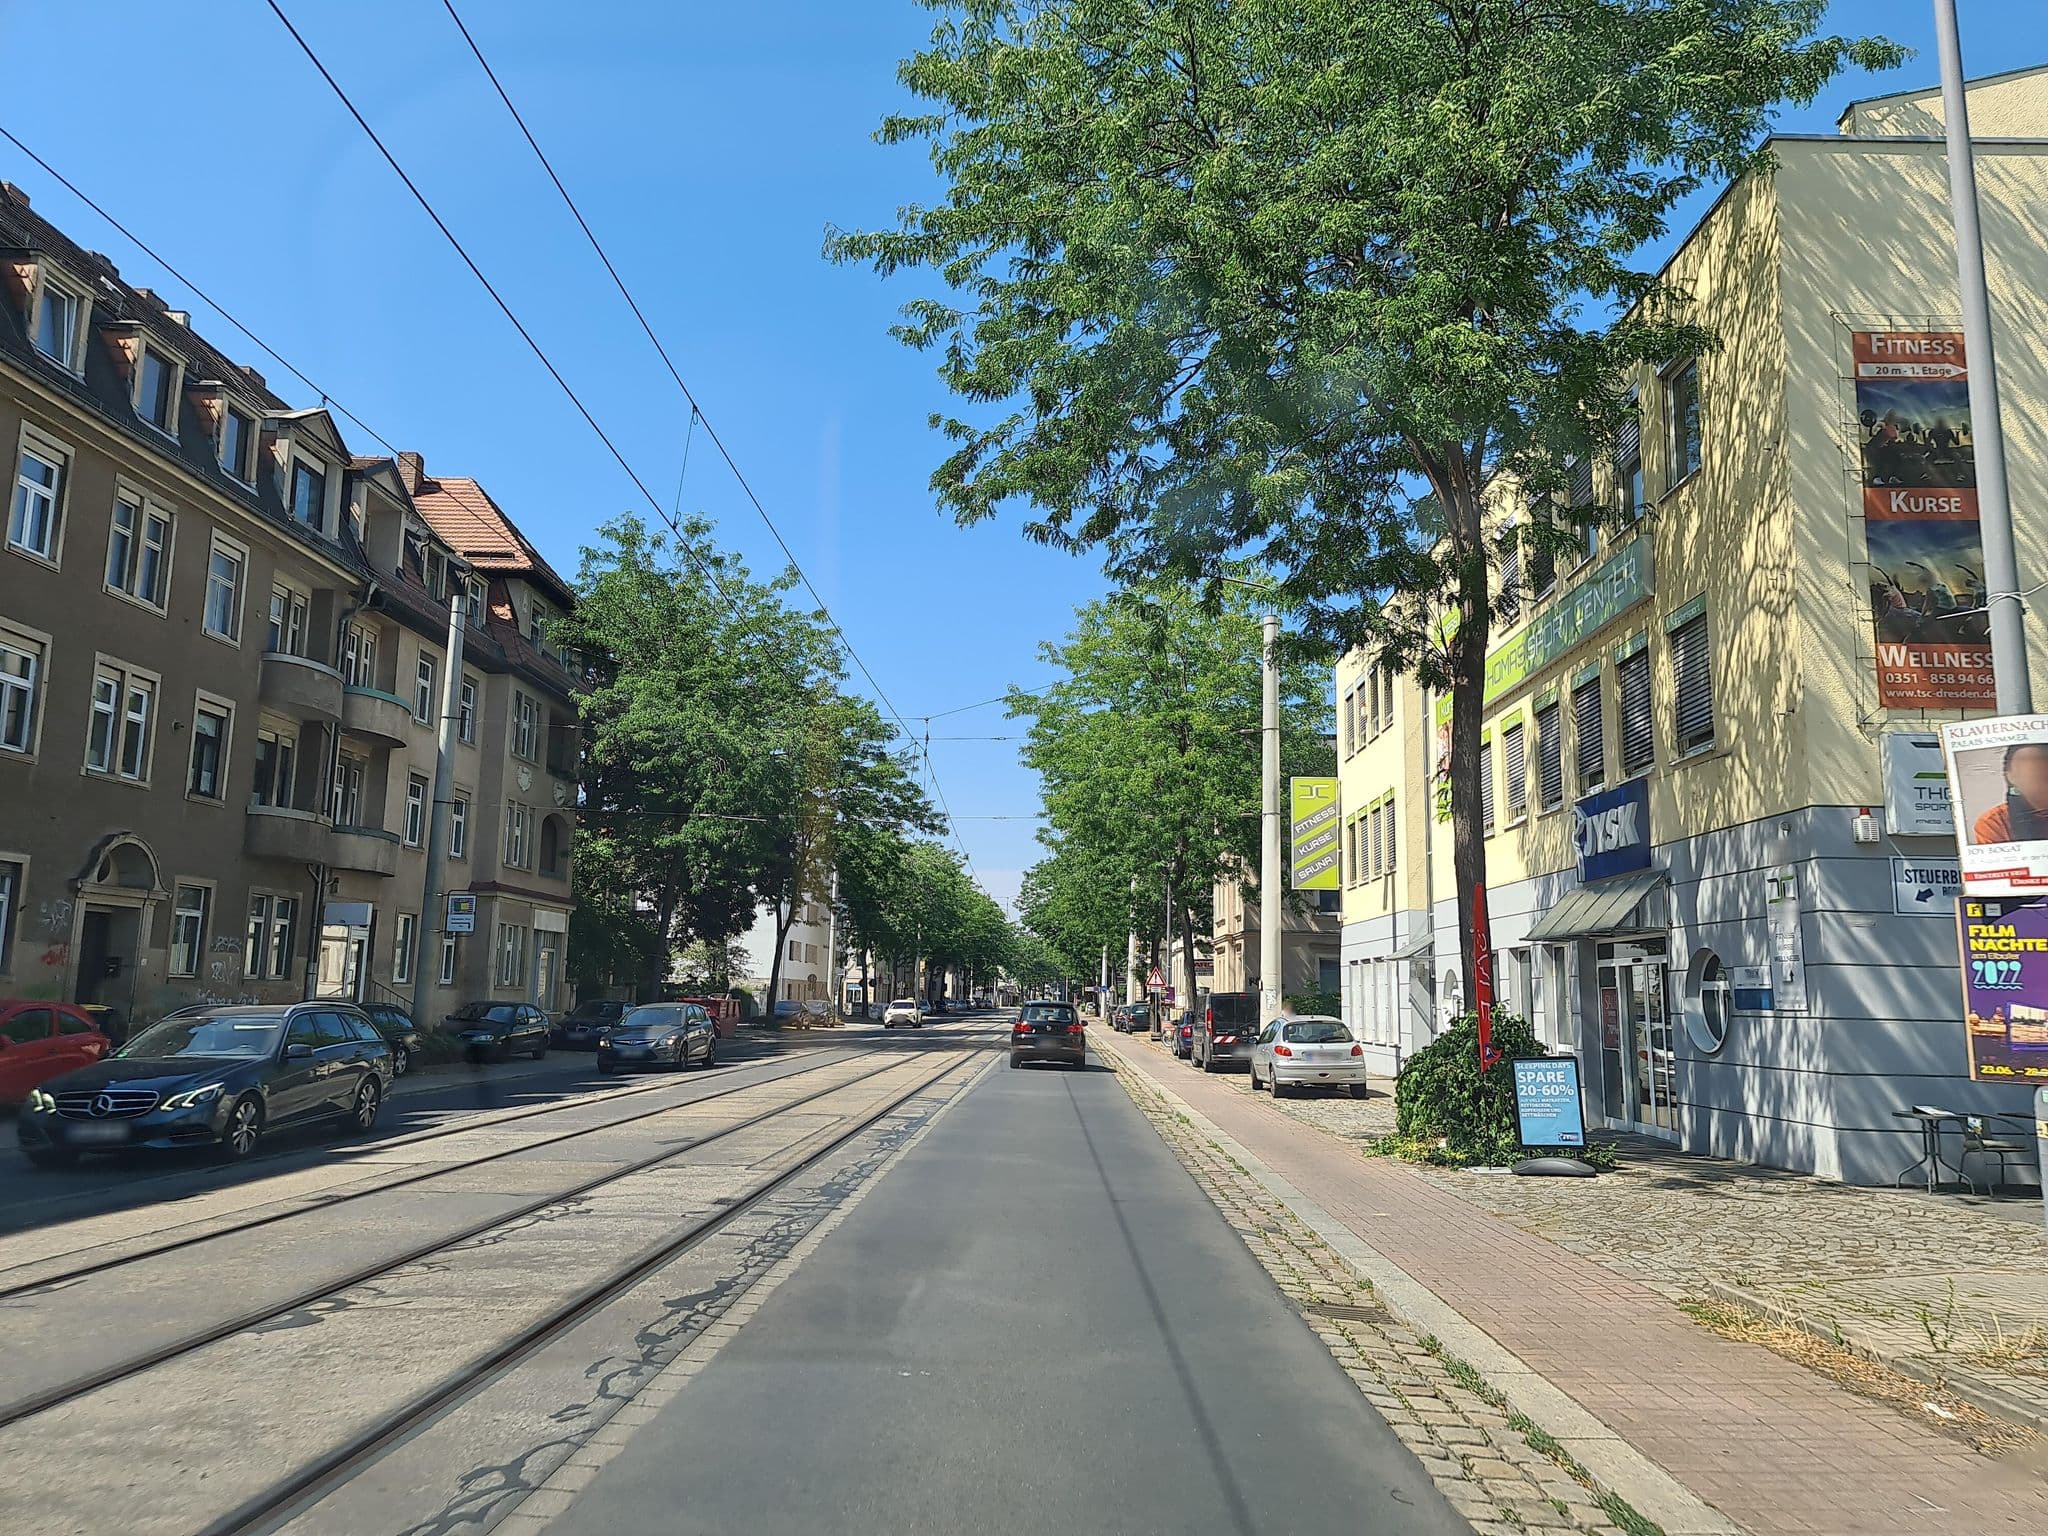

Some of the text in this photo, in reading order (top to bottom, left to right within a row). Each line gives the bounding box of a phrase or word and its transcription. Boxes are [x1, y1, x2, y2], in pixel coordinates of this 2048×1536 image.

[1875, 366, 1889, 375] 20
[1891, 367, 1901, 375] m
[1910, 366, 1919, 375] 1.
[1921, 366, 1952, 377] Etage
[1527, 607, 1570, 659] SPORT
[1574, 556, 1636, 628] CENTER
[1885, 673, 1919, 684] 0351
[1930, 673, 1955, 684] 858
[1958, 674, 1975, 684] 94
[1977, 674, 1994, 685] 66
[1885, 689, 1997, 699] www.tsc-dresden.de
[1295, 806, 1336, 834] FITNESS
[1584, 802, 1640, 857] JYSK
[1298, 832, 1333, 855] KURSE
[1298, 856, 1333, 880] SAUNA
[1904, 868, 1962, 885] STEUERB
[1968, 924, 2016, 937] FILM
[1972, 960, 2023, 985] 2022
[1518, 1071, 1566, 1083] SPARE
[1519, 1084, 1575, 1096] 20-60%
